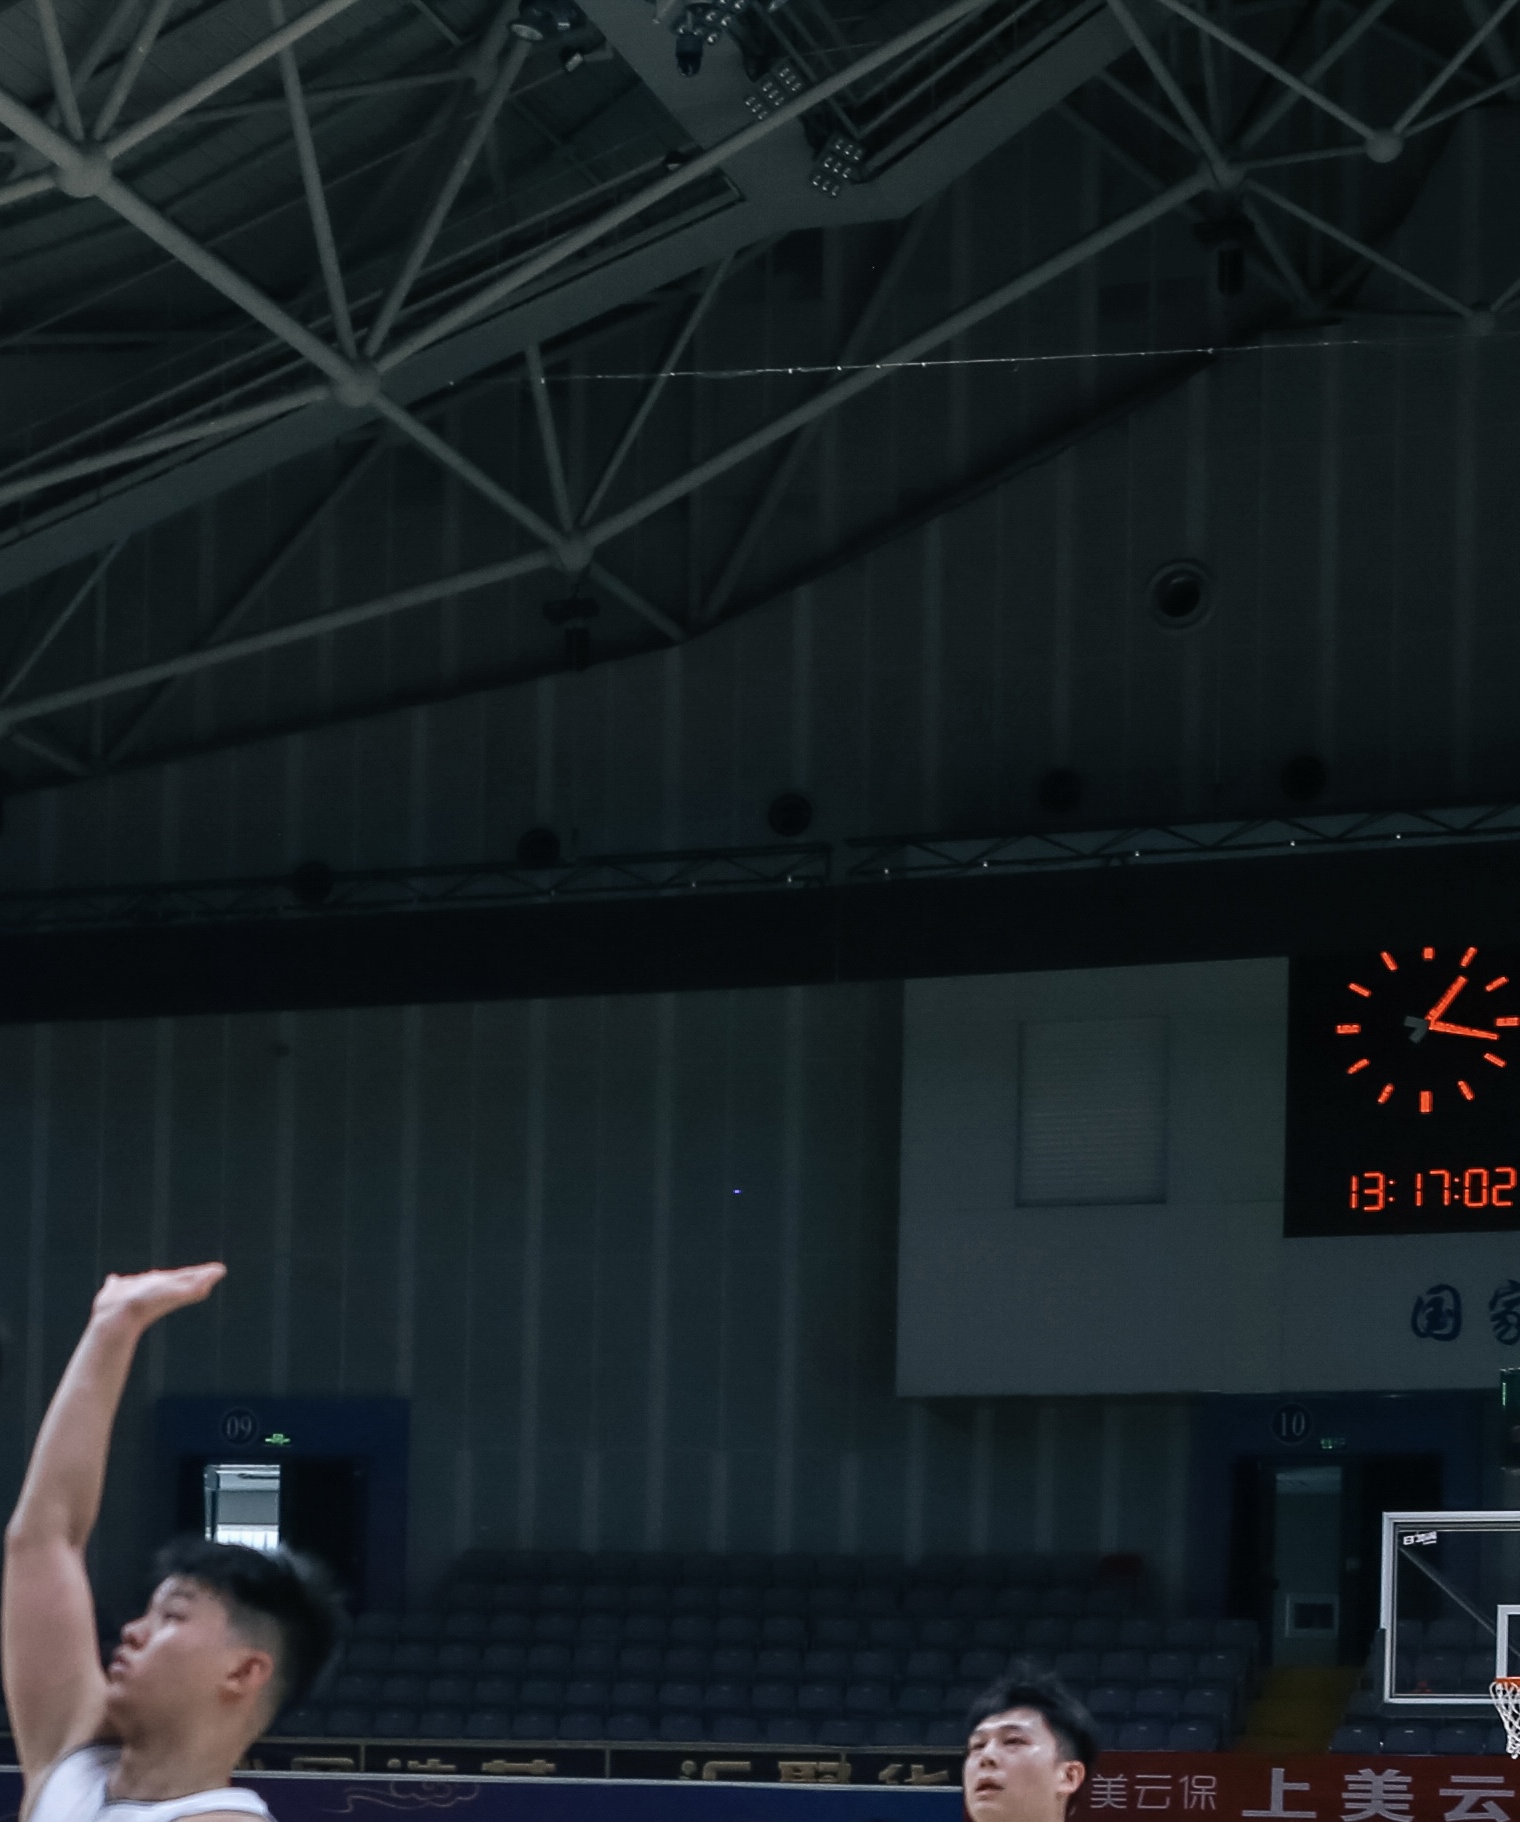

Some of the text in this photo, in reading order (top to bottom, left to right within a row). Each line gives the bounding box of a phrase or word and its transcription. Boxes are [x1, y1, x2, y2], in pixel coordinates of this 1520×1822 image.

[1350, 1167, 1517, 1212] 13:17:02
[1281, 1411, 1305, 1436] 10
[1090, 1773, 1218, 1811] 美云保
